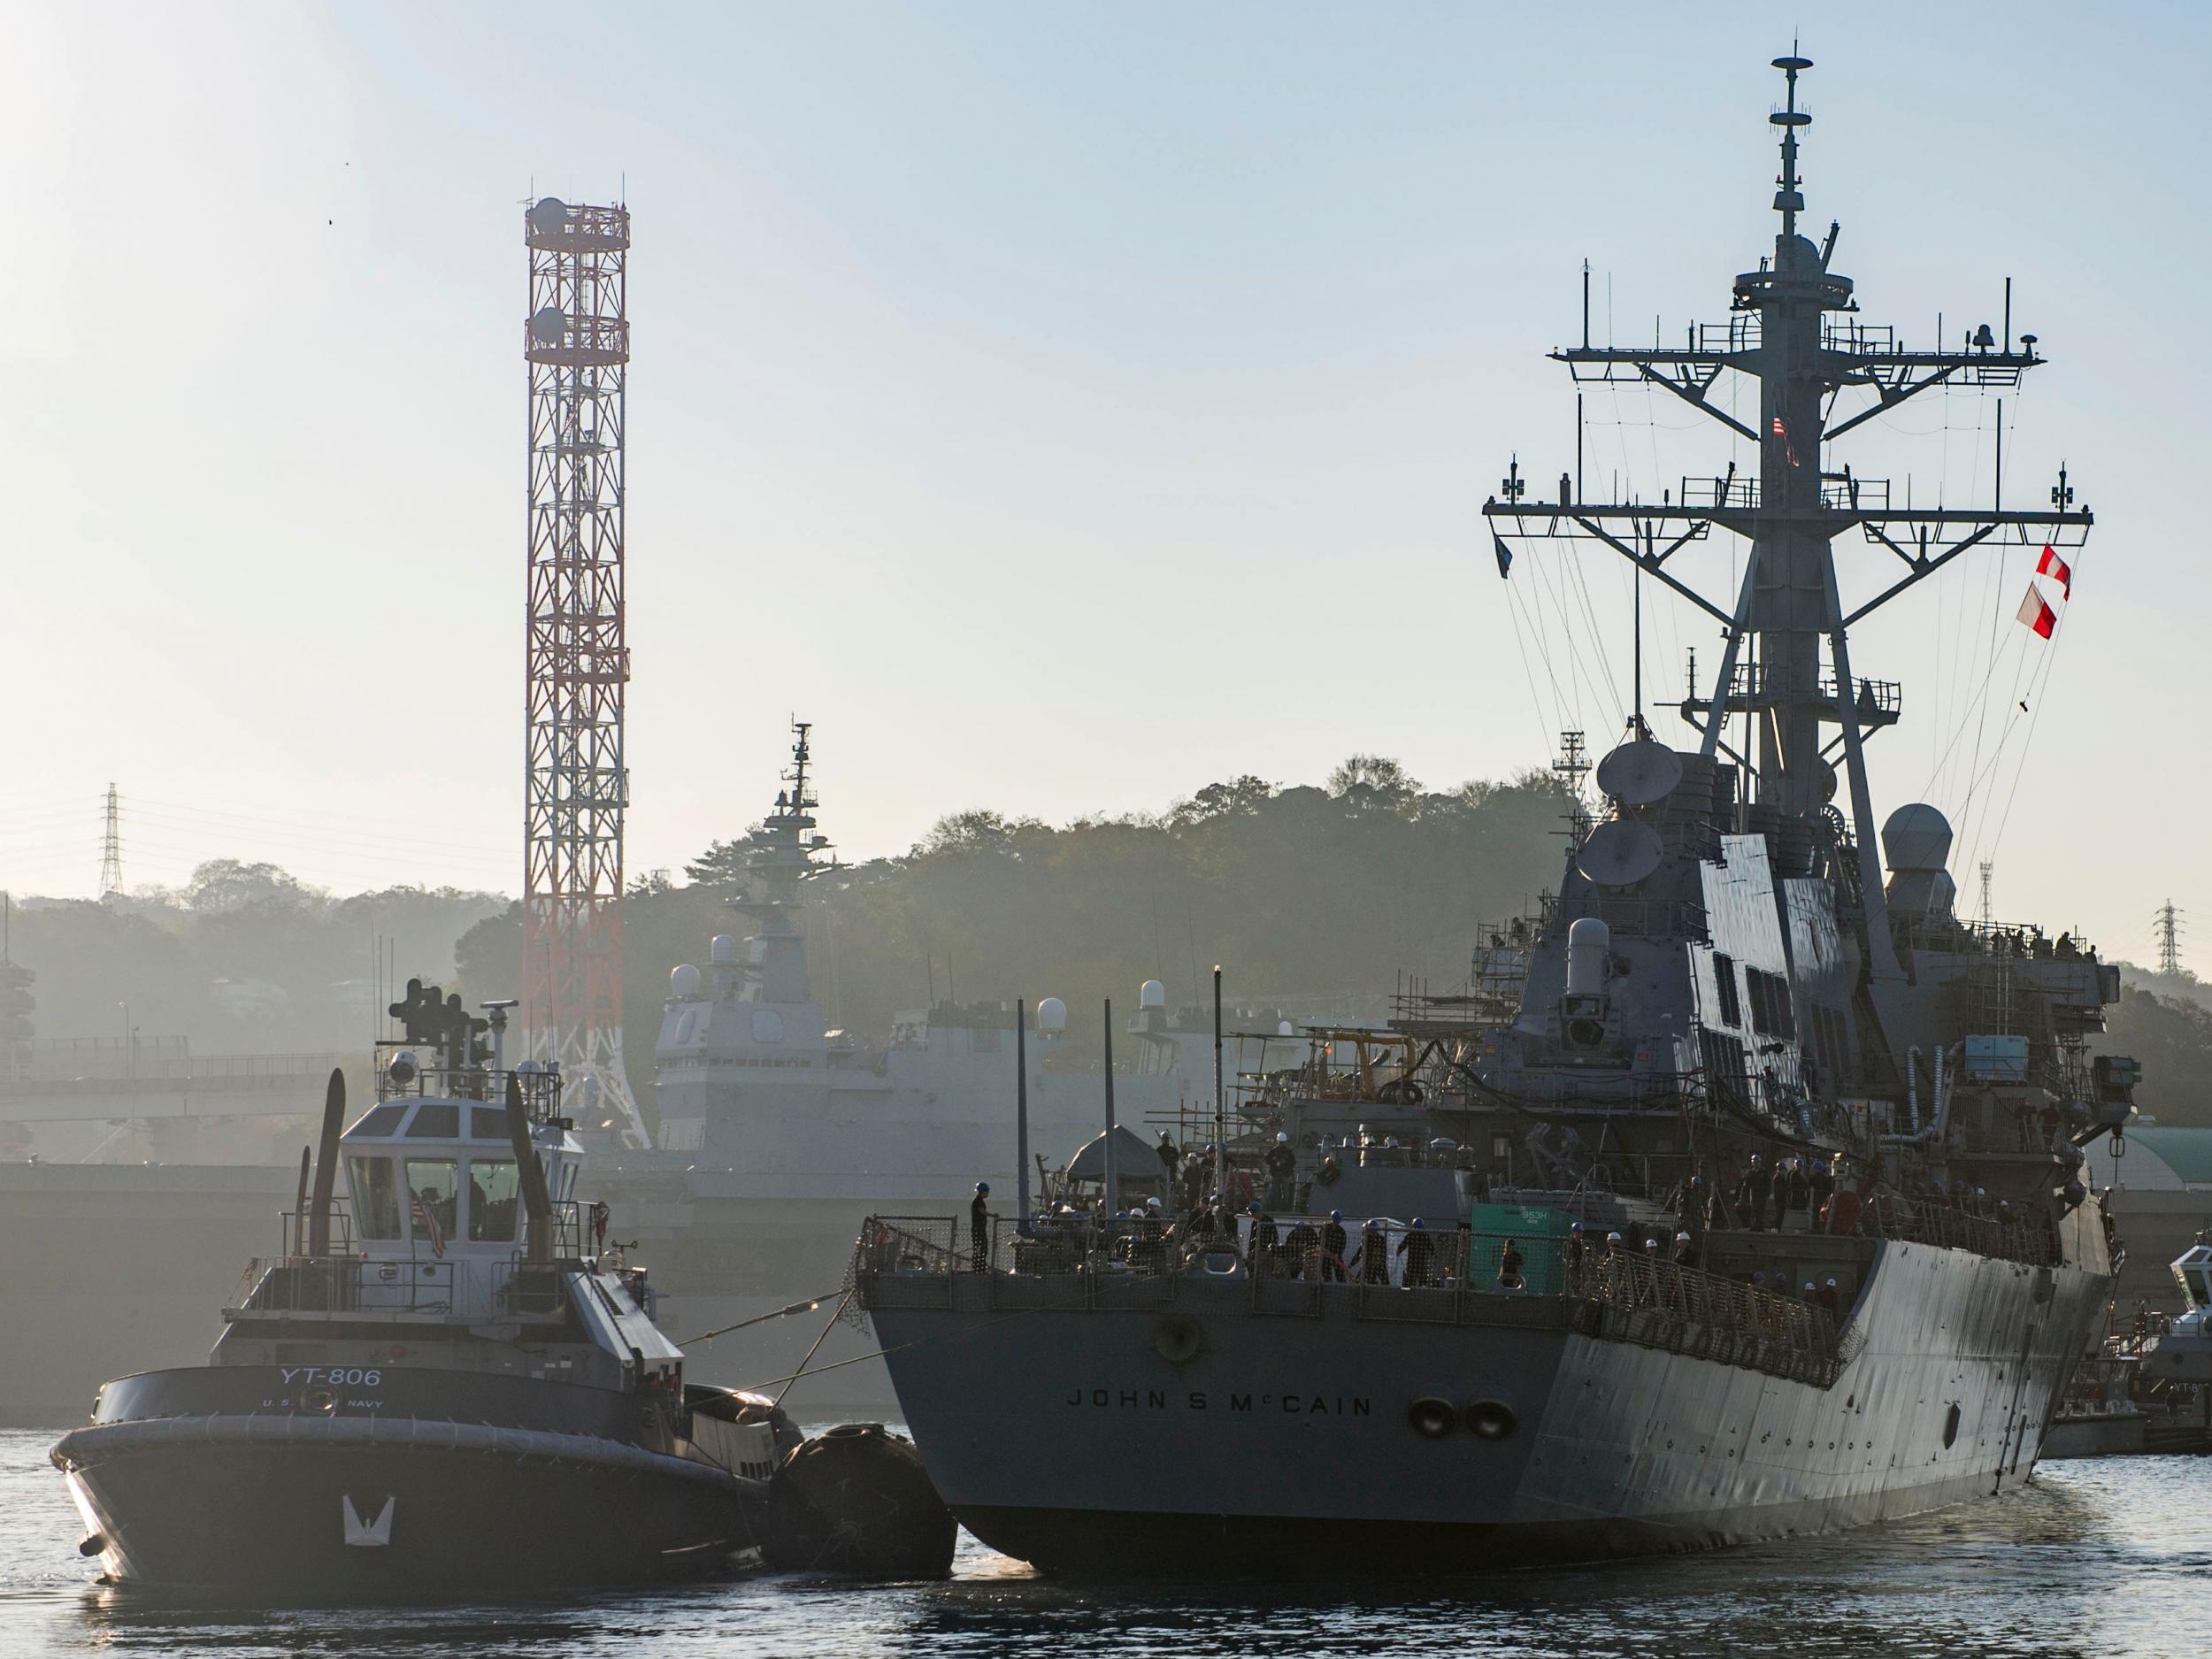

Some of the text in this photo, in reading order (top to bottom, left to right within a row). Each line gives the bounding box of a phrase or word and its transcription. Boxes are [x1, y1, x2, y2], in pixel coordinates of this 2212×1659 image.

[281, 1368, 381, 1386] YT-806
[348, 1400, 383, 1409] NAVY
[1067, 1388, 1165, 1409] JOHN
[1188, 1392, 1208, 1410] S
